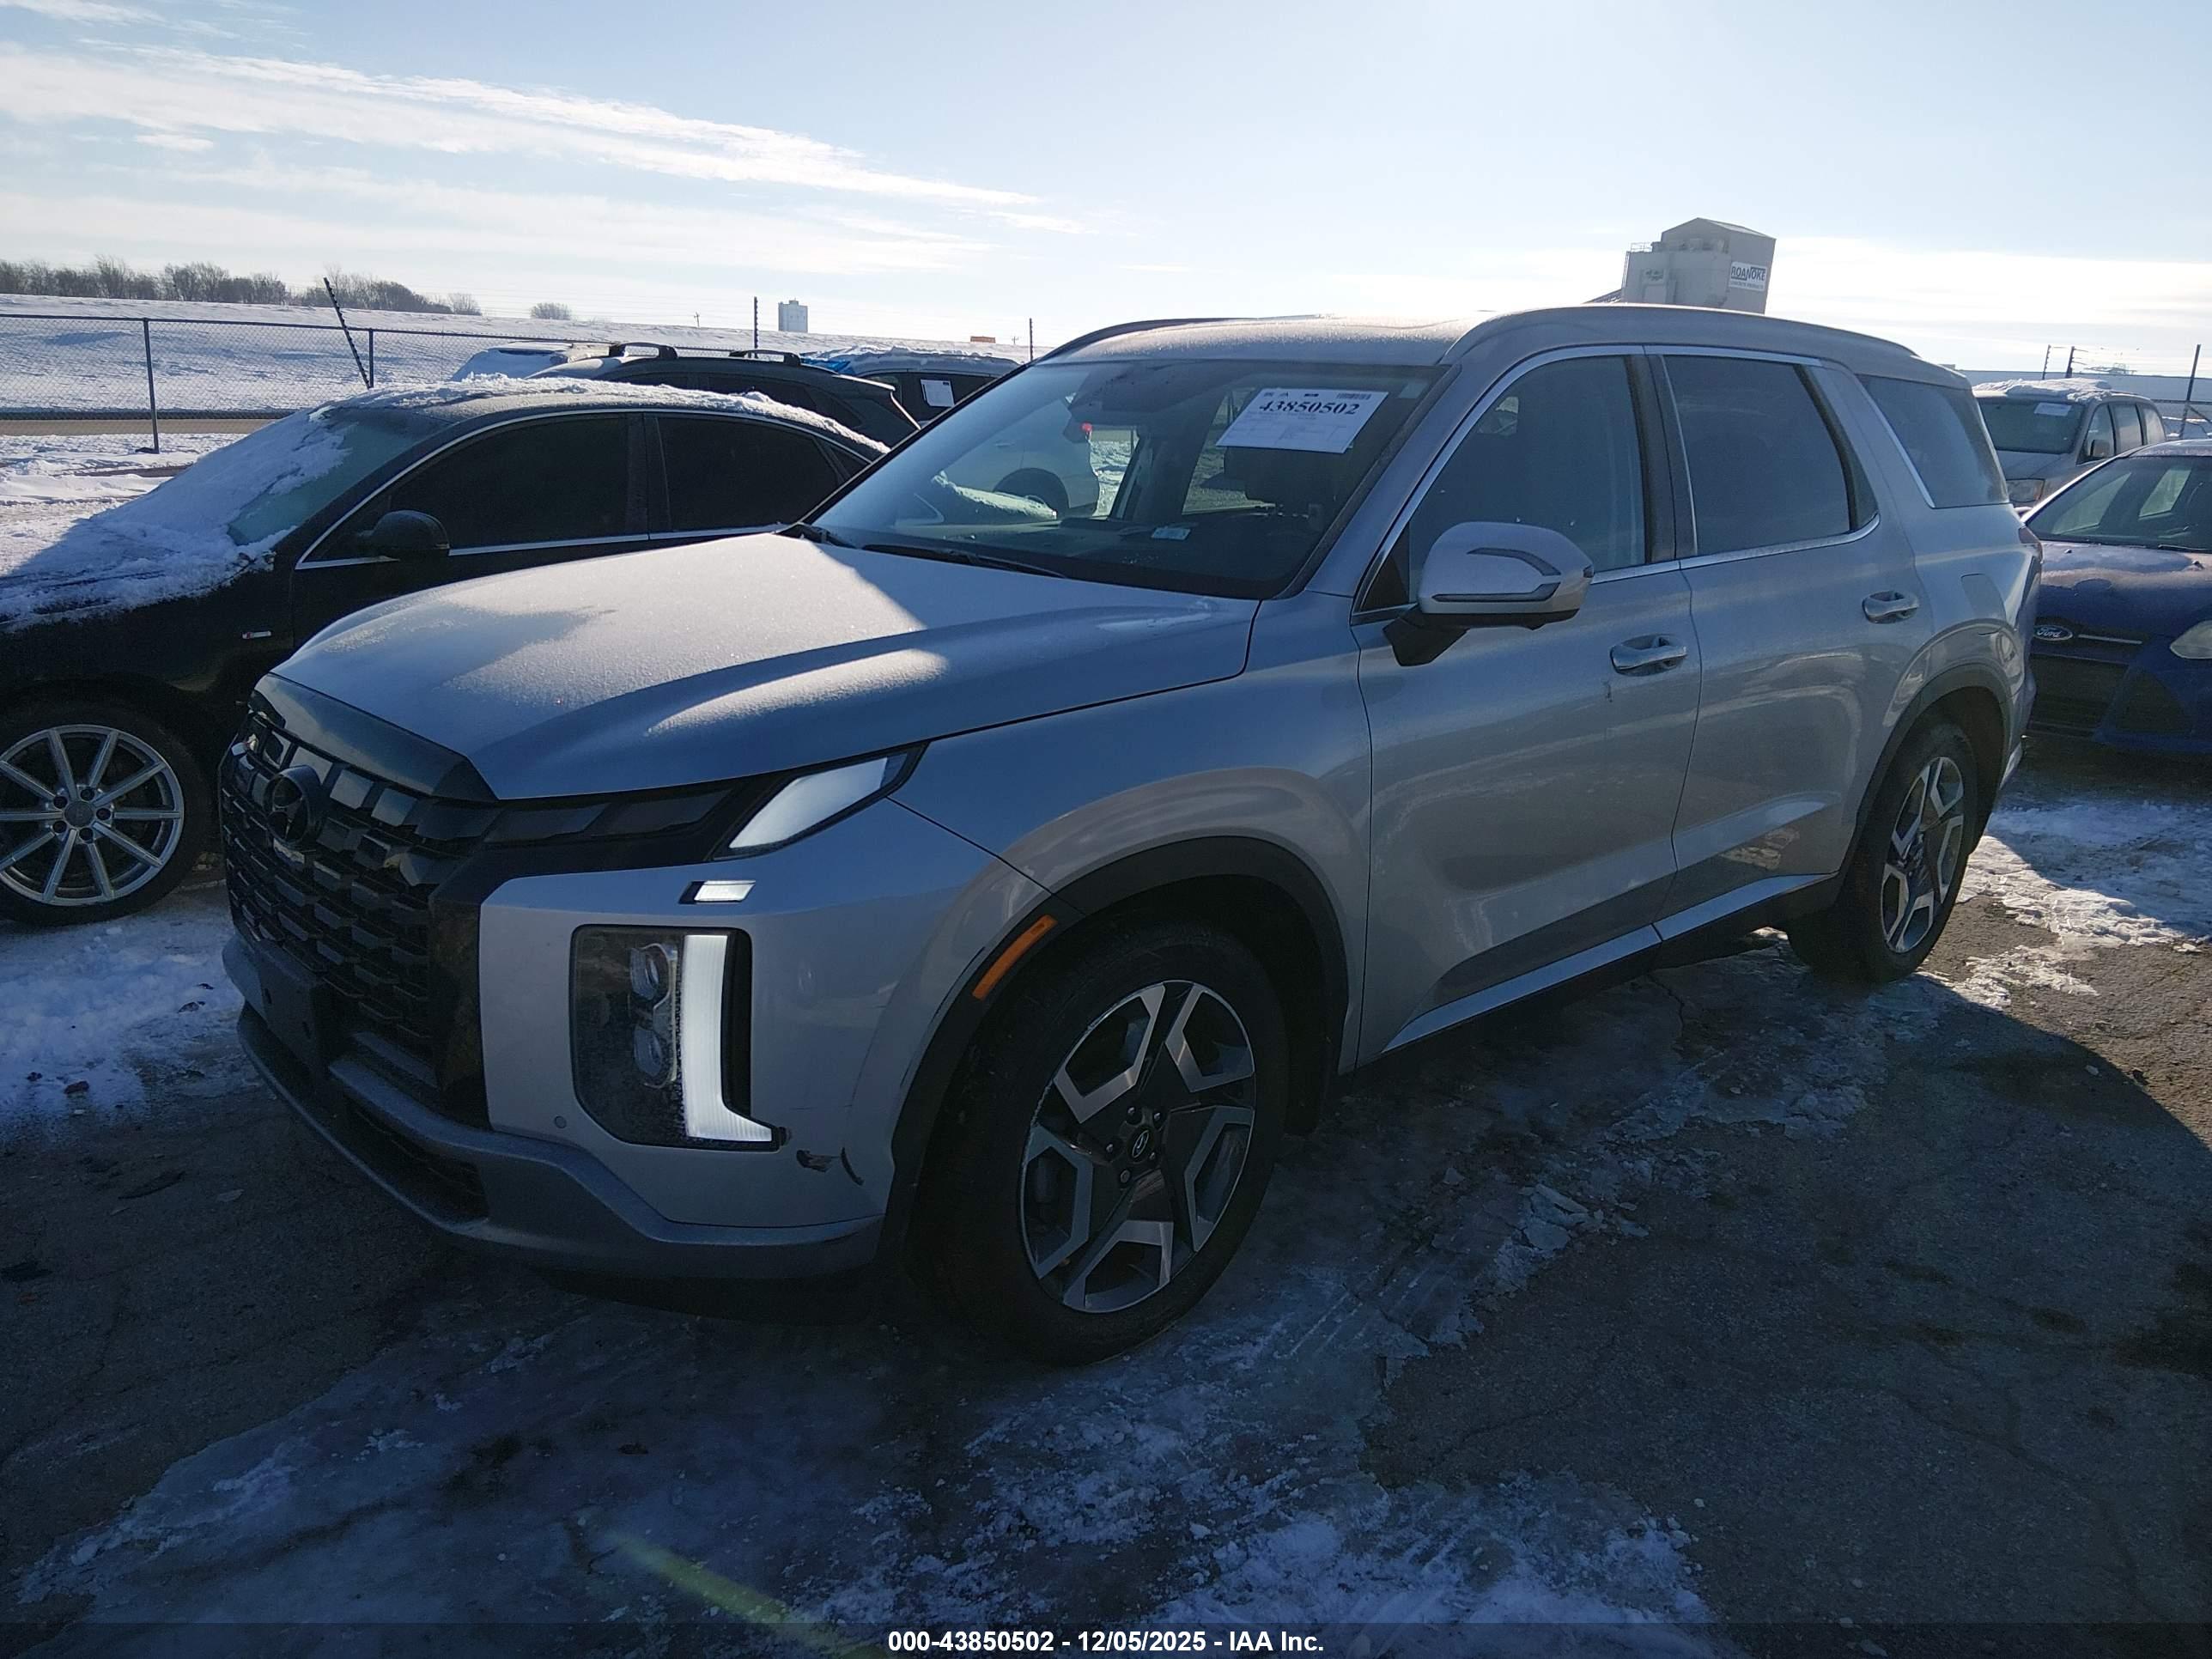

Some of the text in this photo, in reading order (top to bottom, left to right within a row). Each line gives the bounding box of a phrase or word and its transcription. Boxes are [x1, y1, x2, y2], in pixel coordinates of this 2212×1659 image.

[1730, 265, 1765, 281] ROANOKE
[1259, 400, 1360, 415] 43850502
[2036, 627, 2062, 638] Ford
